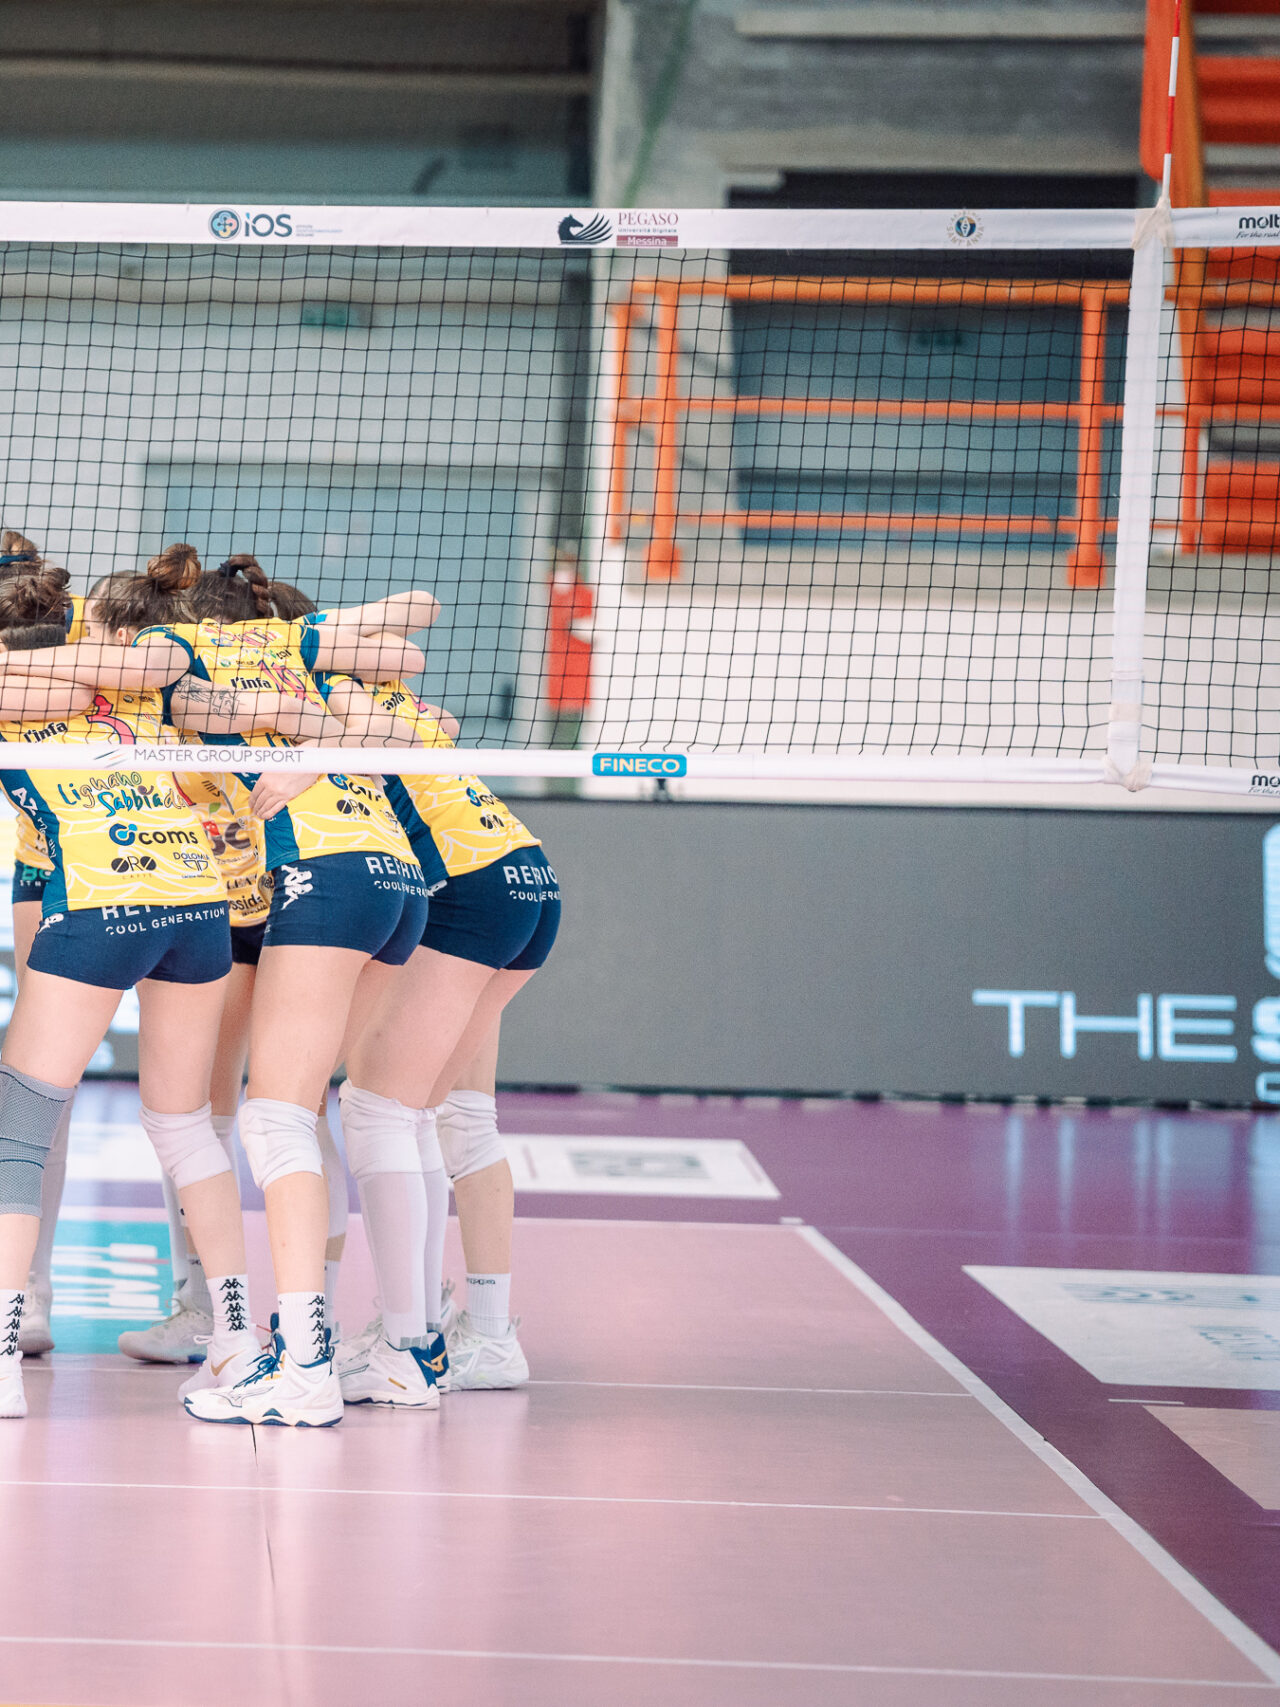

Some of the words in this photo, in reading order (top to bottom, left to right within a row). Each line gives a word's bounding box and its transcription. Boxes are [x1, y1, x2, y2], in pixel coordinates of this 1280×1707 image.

[618, 211, 679, 226] PEGASO
[1238, 213, 1280, 229] molt
[627, 236, 667, 246] Messina
[134, 748, 193, 762] MASTER
[197, 749, 252, 763] GROUP
[255, 750, 304, 763] SPORT
[600, 758, 680, 773] FINECO
[58, 772, 142, 808] Lignano
[98, 786, 188, 818] Sabbiad
[105, 921, 147, 936] COOL
[152, 907, 225, 929] GENERATION
[972, 989, 1238, 1063] THE
